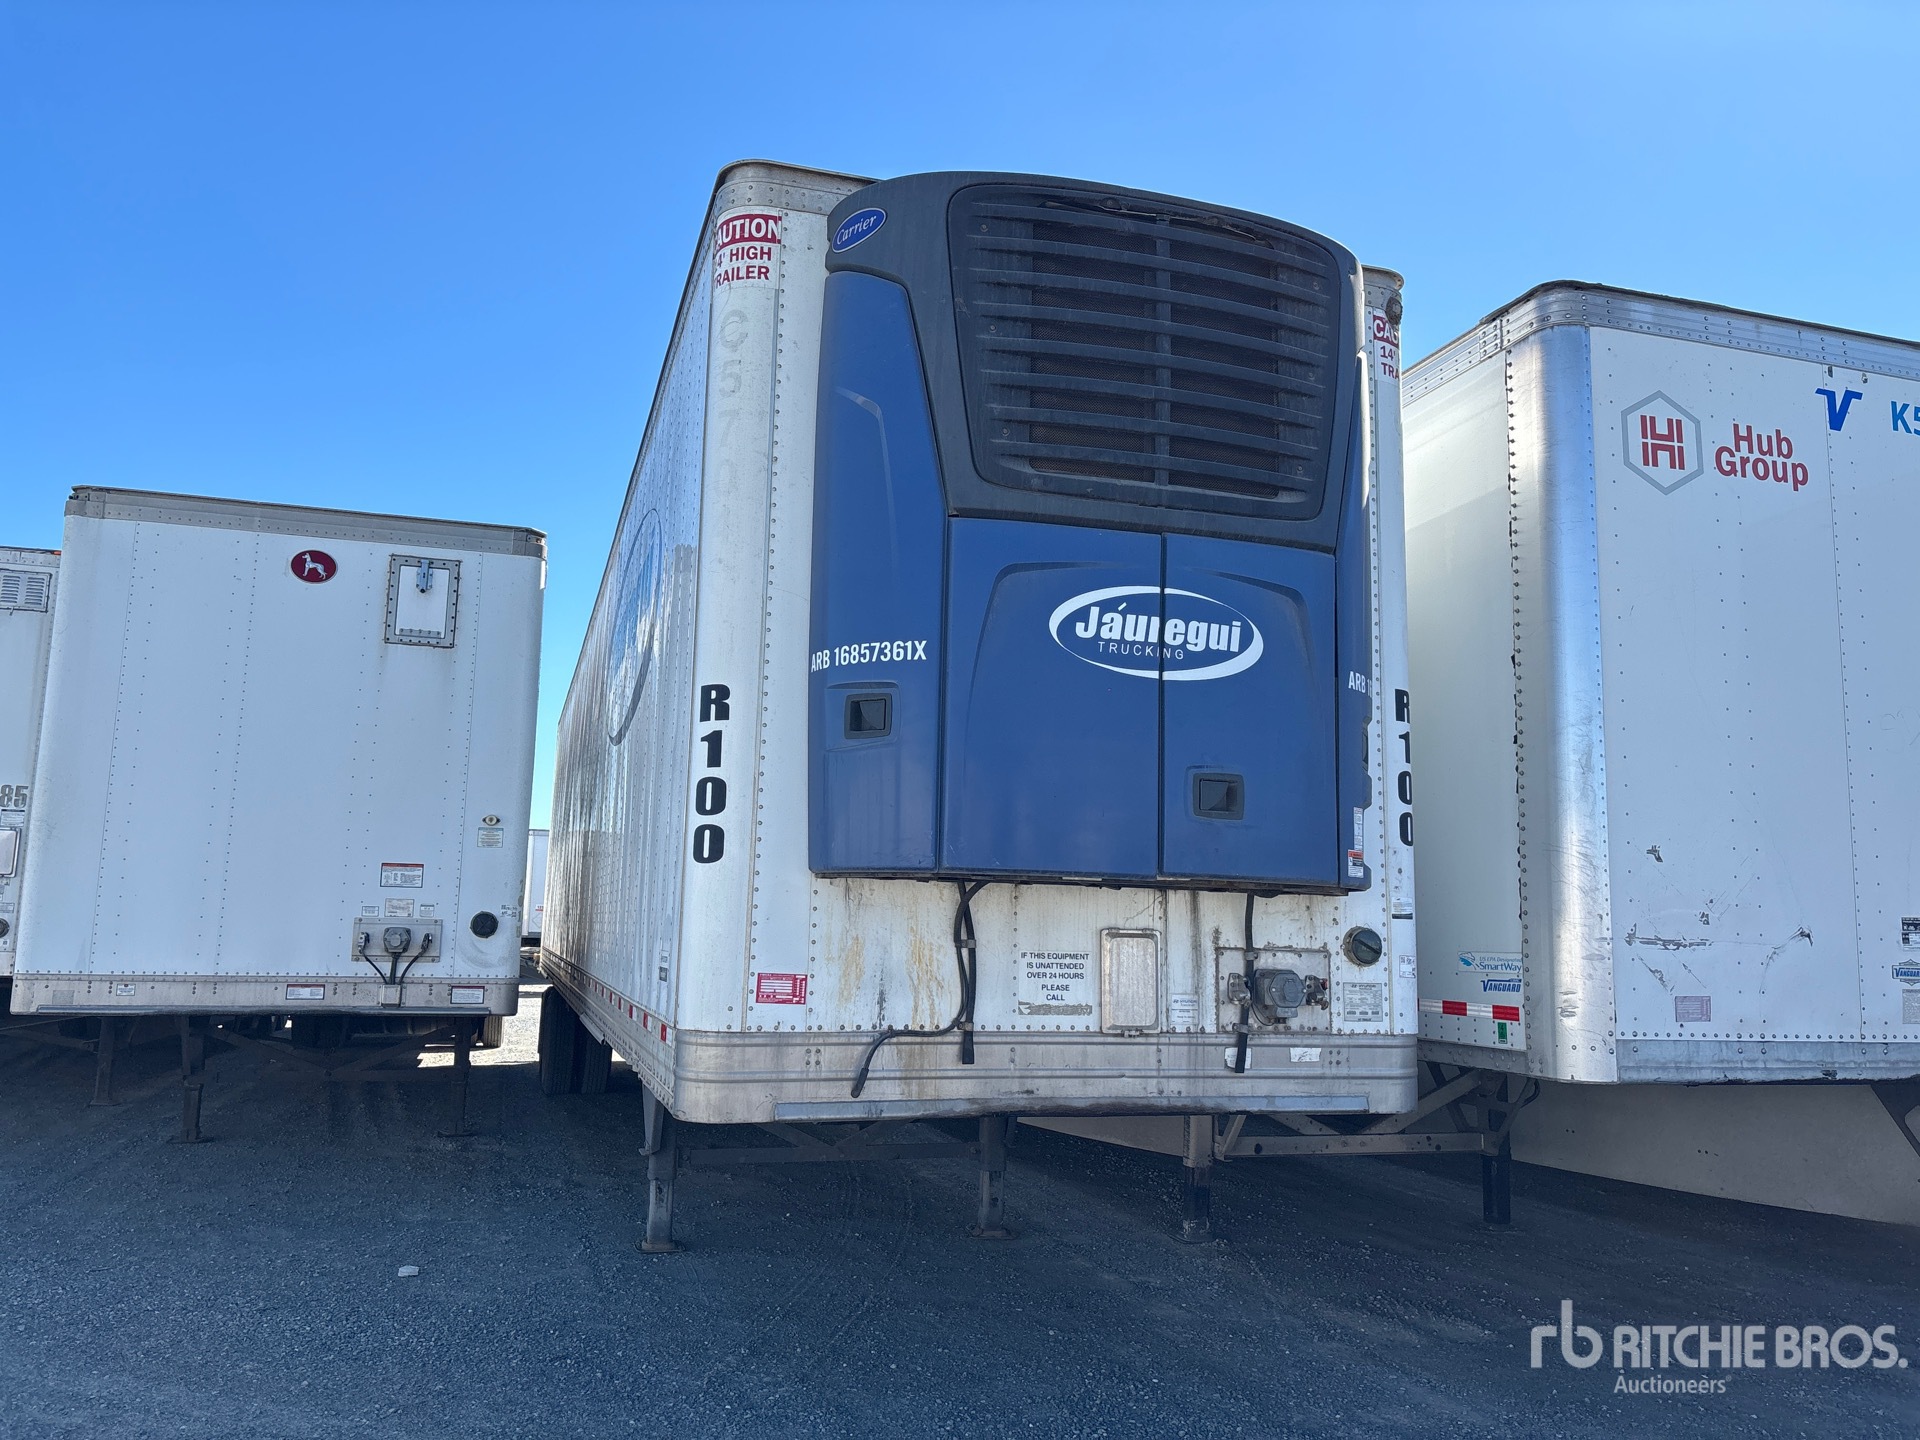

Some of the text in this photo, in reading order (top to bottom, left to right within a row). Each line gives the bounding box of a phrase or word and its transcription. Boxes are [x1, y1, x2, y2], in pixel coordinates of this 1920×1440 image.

[717, 217, 781, 248] AUTION
[836, 215, 877, 246] Carrier
[729, 245, 772, 263] HIGH
[1733, 423, 1793, 459] Hub
[1715, 446, 1809, 491] Group
[811, 640, 928, 673] ARB 16857361X
[1098, 641, 1184, 660] TRUCKING
[1348, 670, 1366, 694] ARB
[693, 683, 731, 864] R100
[1035, 962, 1084, 970] UNATTENDED
[1479, 961, 1522, 974] SmartWay
[1480, 978, 1522, 993] VANGUARD
